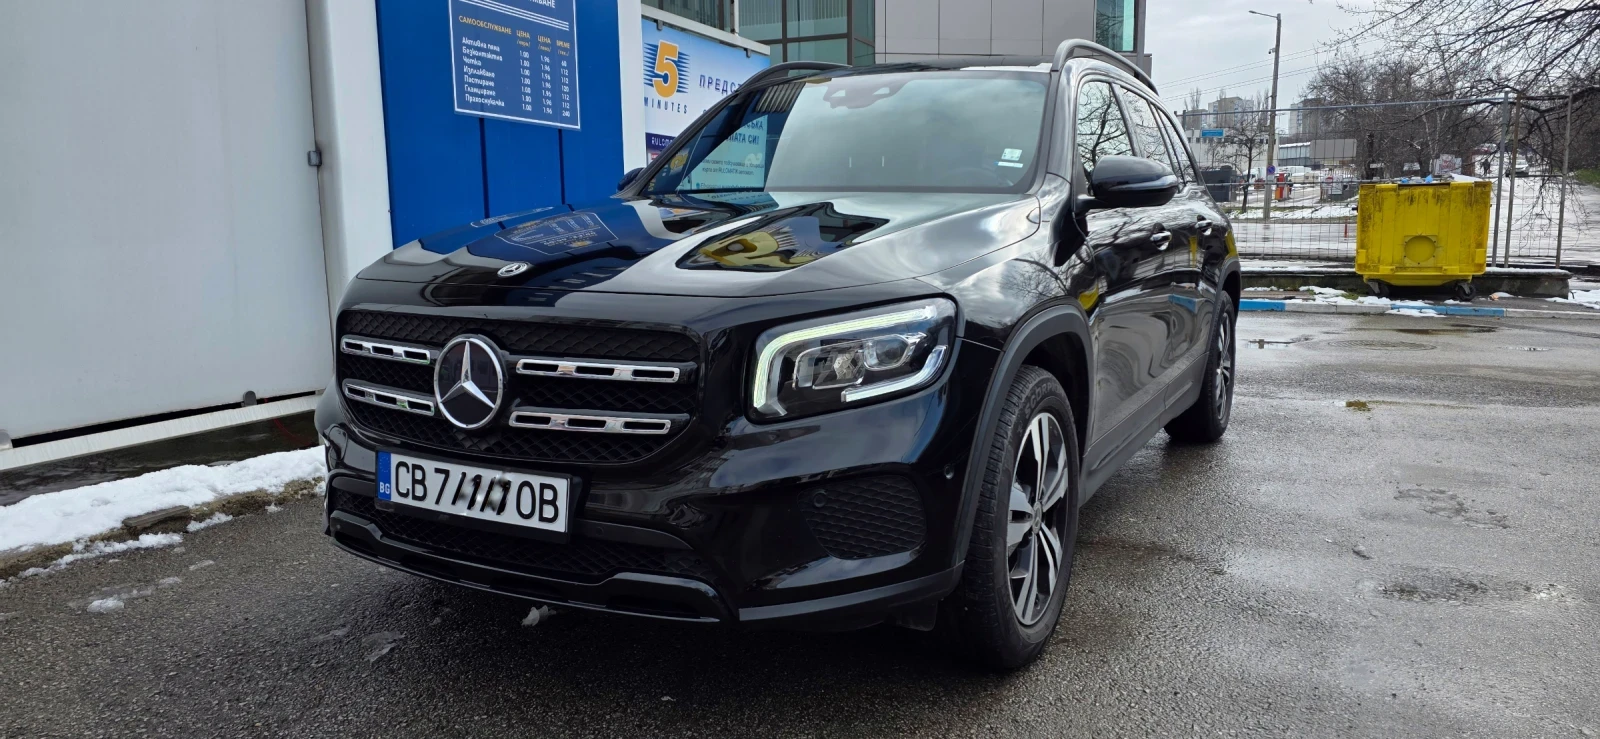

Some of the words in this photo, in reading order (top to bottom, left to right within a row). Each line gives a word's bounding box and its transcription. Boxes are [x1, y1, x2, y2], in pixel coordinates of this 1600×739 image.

[459, 16, 512, 35] САМООБСЛУЖВАНЕ
[516, 30, 530, 39] ЦЕНА
[652, 40, 678, 98] 5
[643, 96, 688, 114] MINUTES
[379, 482, 390, 494] BG
